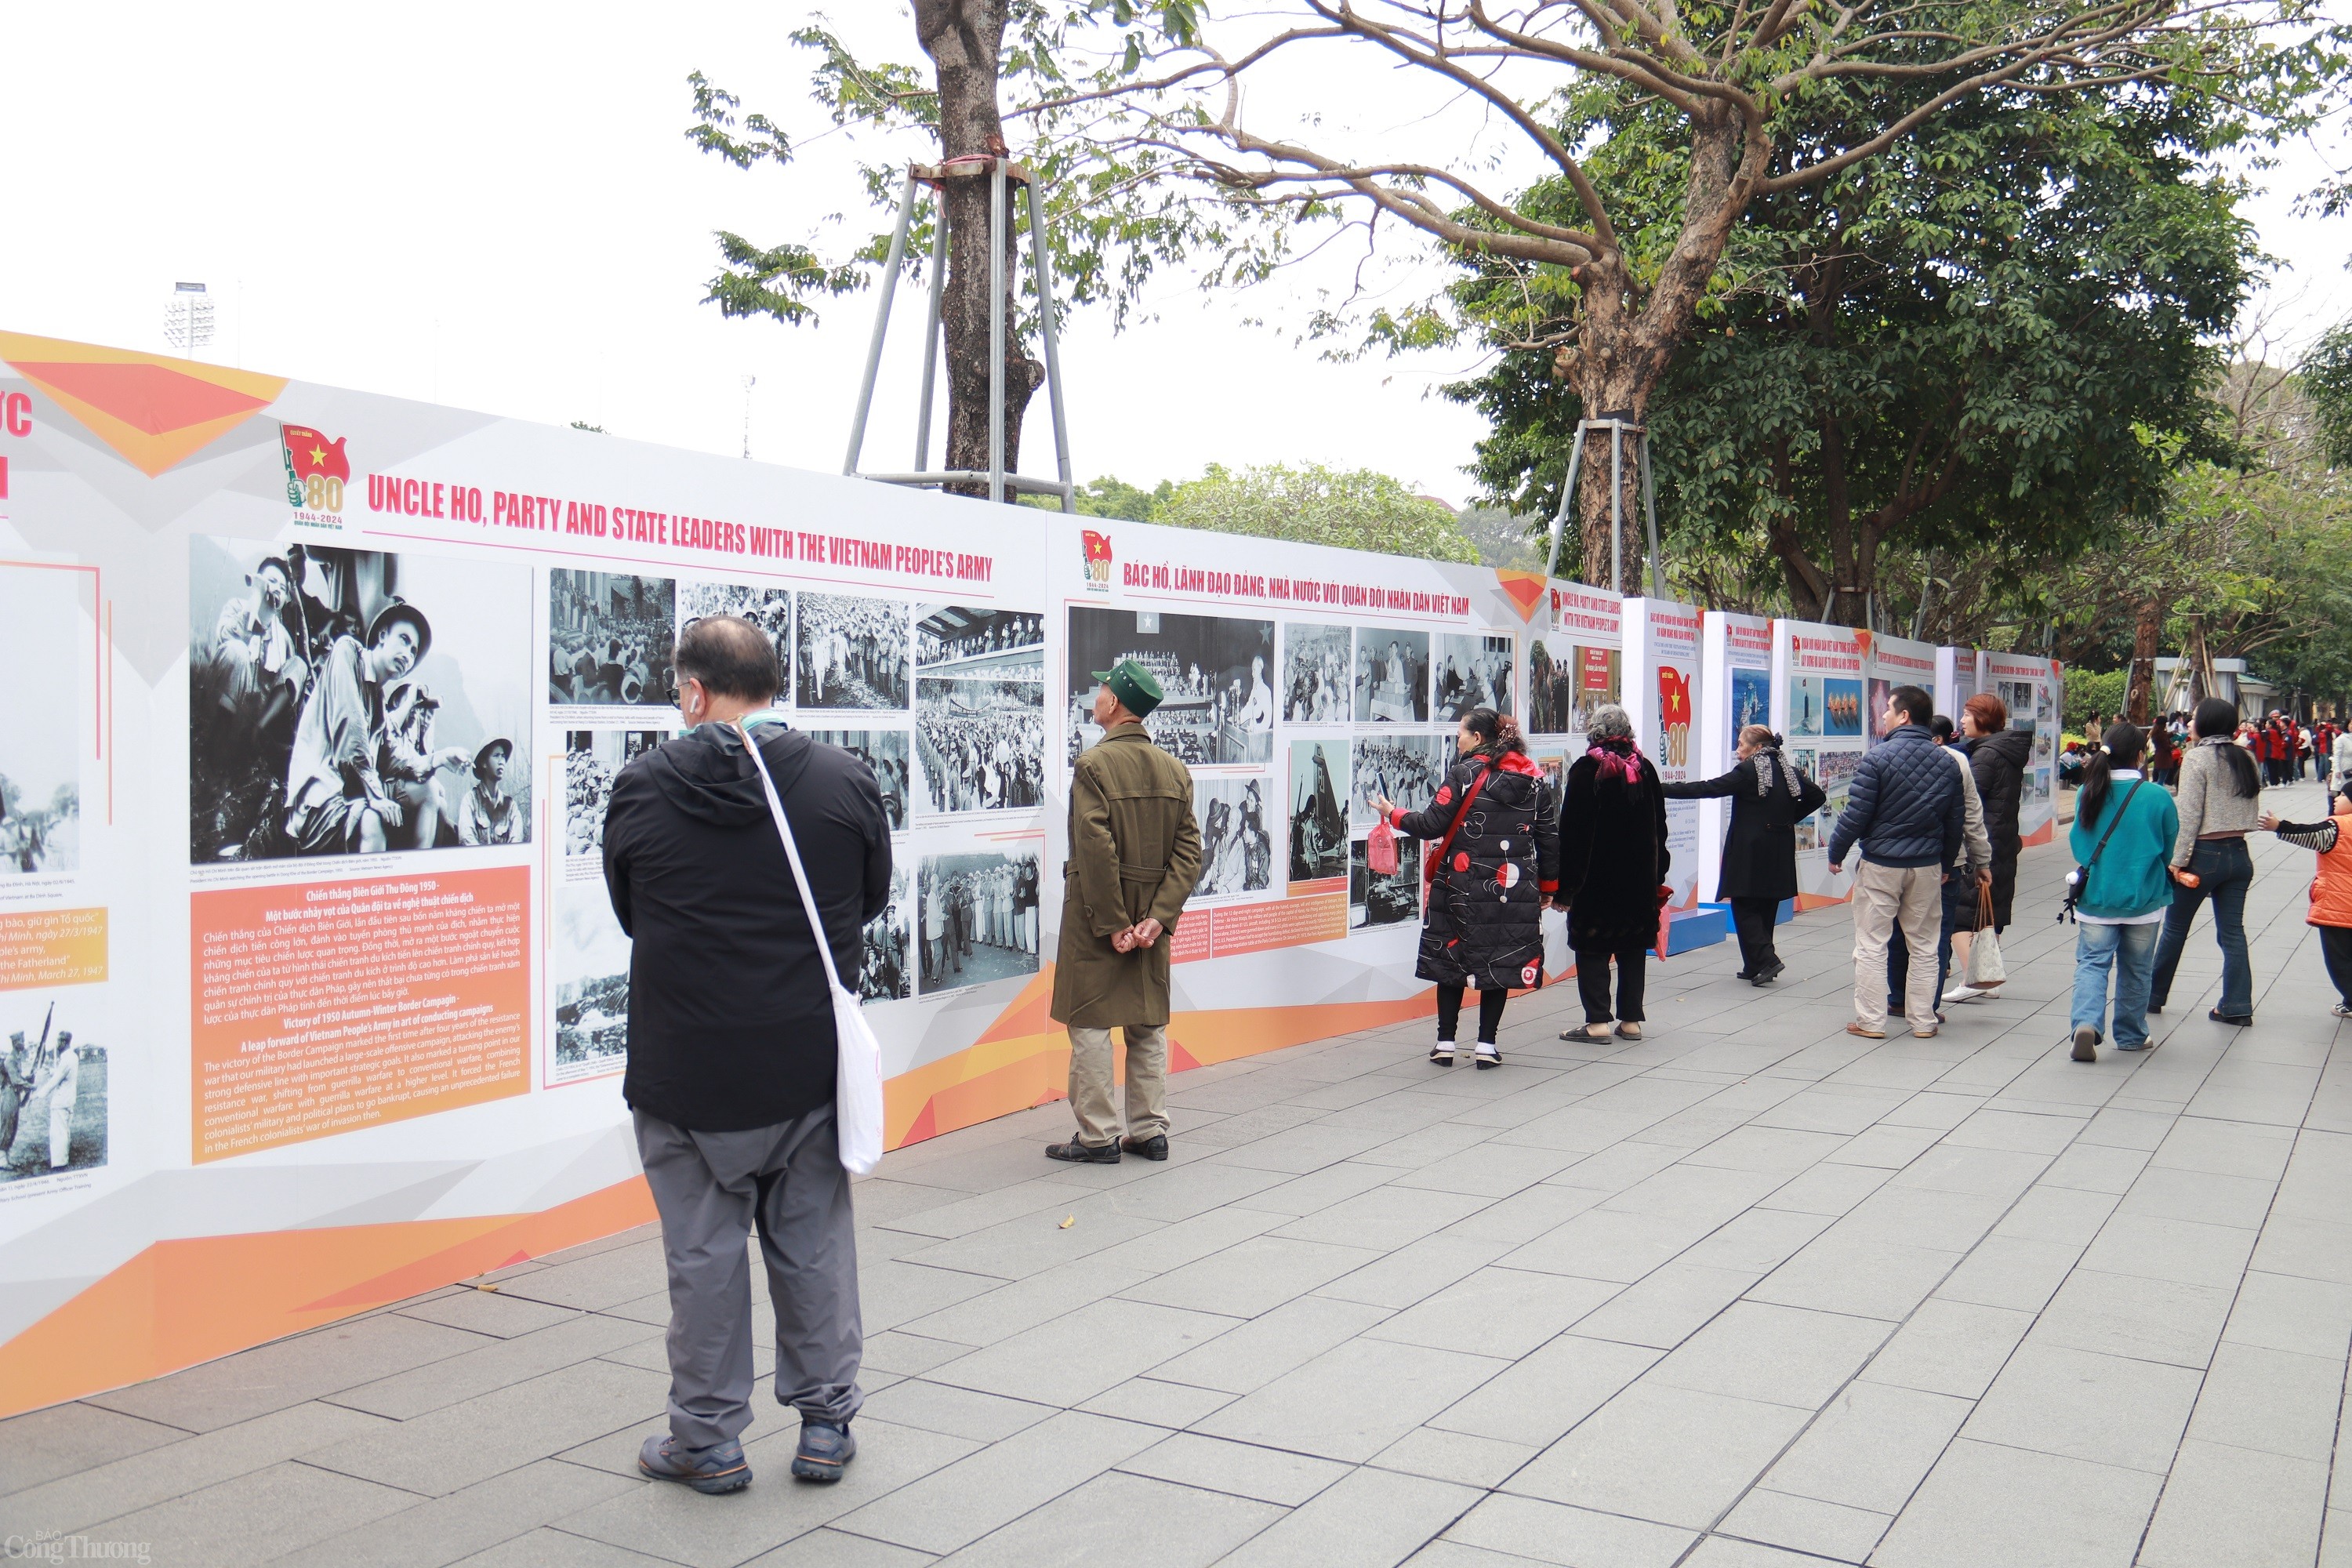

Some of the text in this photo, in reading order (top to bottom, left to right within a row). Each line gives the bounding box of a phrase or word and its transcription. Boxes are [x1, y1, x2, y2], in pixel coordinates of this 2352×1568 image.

[307, 474, 343, 513] 80
[294, 512, 343, 524] 1944-2024
[368, 474, 444, 519] UNCLE
[451, 485, 486, 527] HO,
[493, 492, 561, 532] PARTY
[566, 501, 606, 537] AND
[612, 507, 666, 545] STATE
[672, 515, 745, 554] LEADERS
[750, 526, 793, 559] WITH
[797, 532, 825, 563] THE
[829, 536, 892, 571] VIETNAM
[956, 554, 993, 582] ARMY
[1092, 559, 1109, 582] 80
[1123, 560, 1469, 616] BÁC HỒ, LÃNH ĐẠO ĐẢNG, NHÀ NƯỚC VỚI QUÂN ĐỘI NHÂN DÂN VIỆT NAM
[1669, 723, 1687, 767] 80
[1662, 771, 1686, 780] 1944-2024
[266, 891, 473, 923] Một bước nhảy vọt của Quân đội ta về nghệ thuật chiến dịch
[306, 880, 436, 902] Chiến thắng Biên Giới Thu Đông 1950
[5, 918, 25, 927] bào,
[27, 916, 42, 928] giữ
[44, 915, 58, 927] gìn
[60, 912, 70, 923] Tổ
[8, 926, 102, 941] Minh, ngày 27/3/1947
[20, 945, 45, 955] army,
[10, 971, 36, 982] Minh,
[38, 968, 65, 980] March
[67, 967, 79, 977] 27,
[84, 966, 103, 975] 1947
[283, 993, 456, 1029] Victory of 1950 Autumn-Winter Border Campagin
[203, 1013, 520, 1072] The victory of the Border Campaign marked the first time after four years of the resistance
[241, 1041, 247, 1053] A
[248, 1040, 266, 1052] leap
[267, 1032, 299, 1048] forward
[300, 1031, 309, 1043] of
[309, 1028, 342, 1041] Vietnam
[373, 1020, 392, 1032] Army
[392, 1018, 400, 1028] in
[400, 1016, 412, 1027] art
[412, 1013, 420, 1025] of
[420, 1009, 458, 1023] conducting
[458, 1004, 493, 1017] campaigns
[204, 1144, 213, 1153] in
[214, 1141, 229, 1151] the
[230, 1134, 258, 1148] French
[305, 1123, 320, 1132] war
[321, 1118, 330, 1128] of
[331, 1114, 361, 1127] invasion
[362, 1110, 381, 1120] then.
